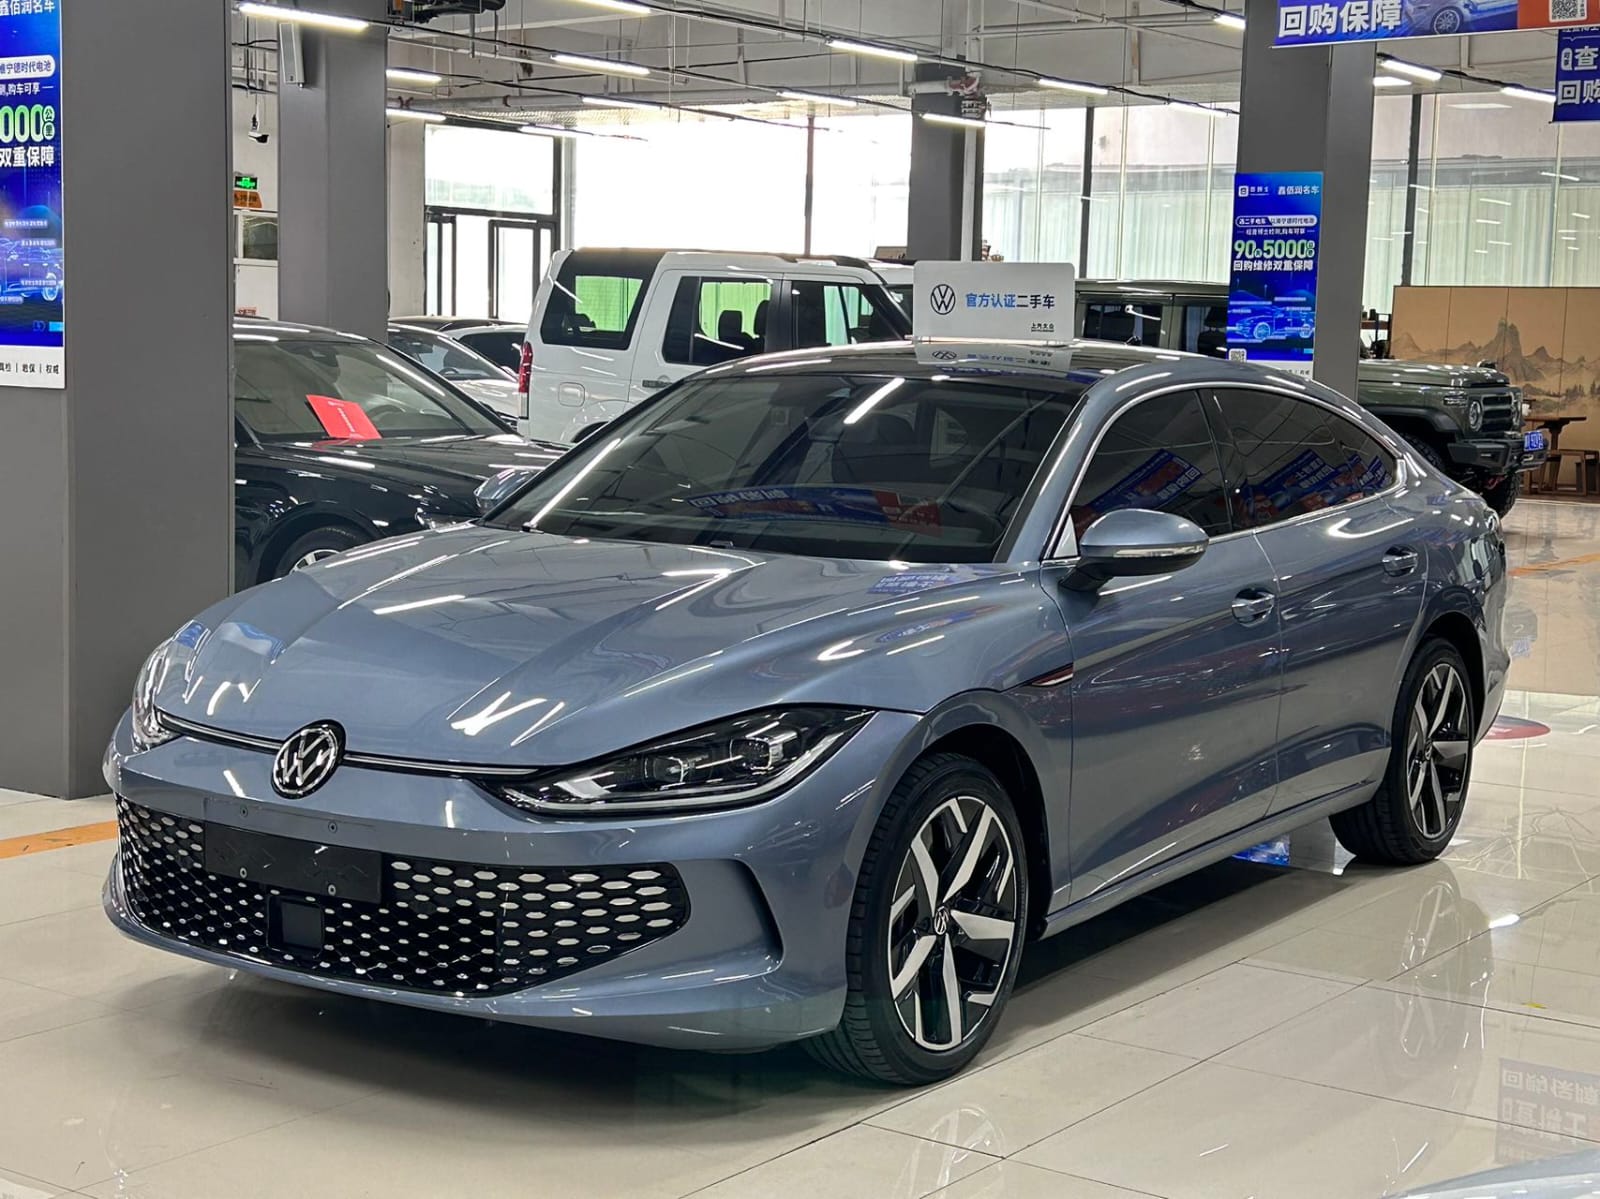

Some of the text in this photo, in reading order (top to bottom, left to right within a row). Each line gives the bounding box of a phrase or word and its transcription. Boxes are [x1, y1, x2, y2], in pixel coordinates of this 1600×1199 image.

[1278, 0, 1402, 37] 回购保障
[1574, 46, 1599, 70] 查
[0, 145, 54, 167] 双重保障
[966, 293, 1055, 309] 官方认证二手车
